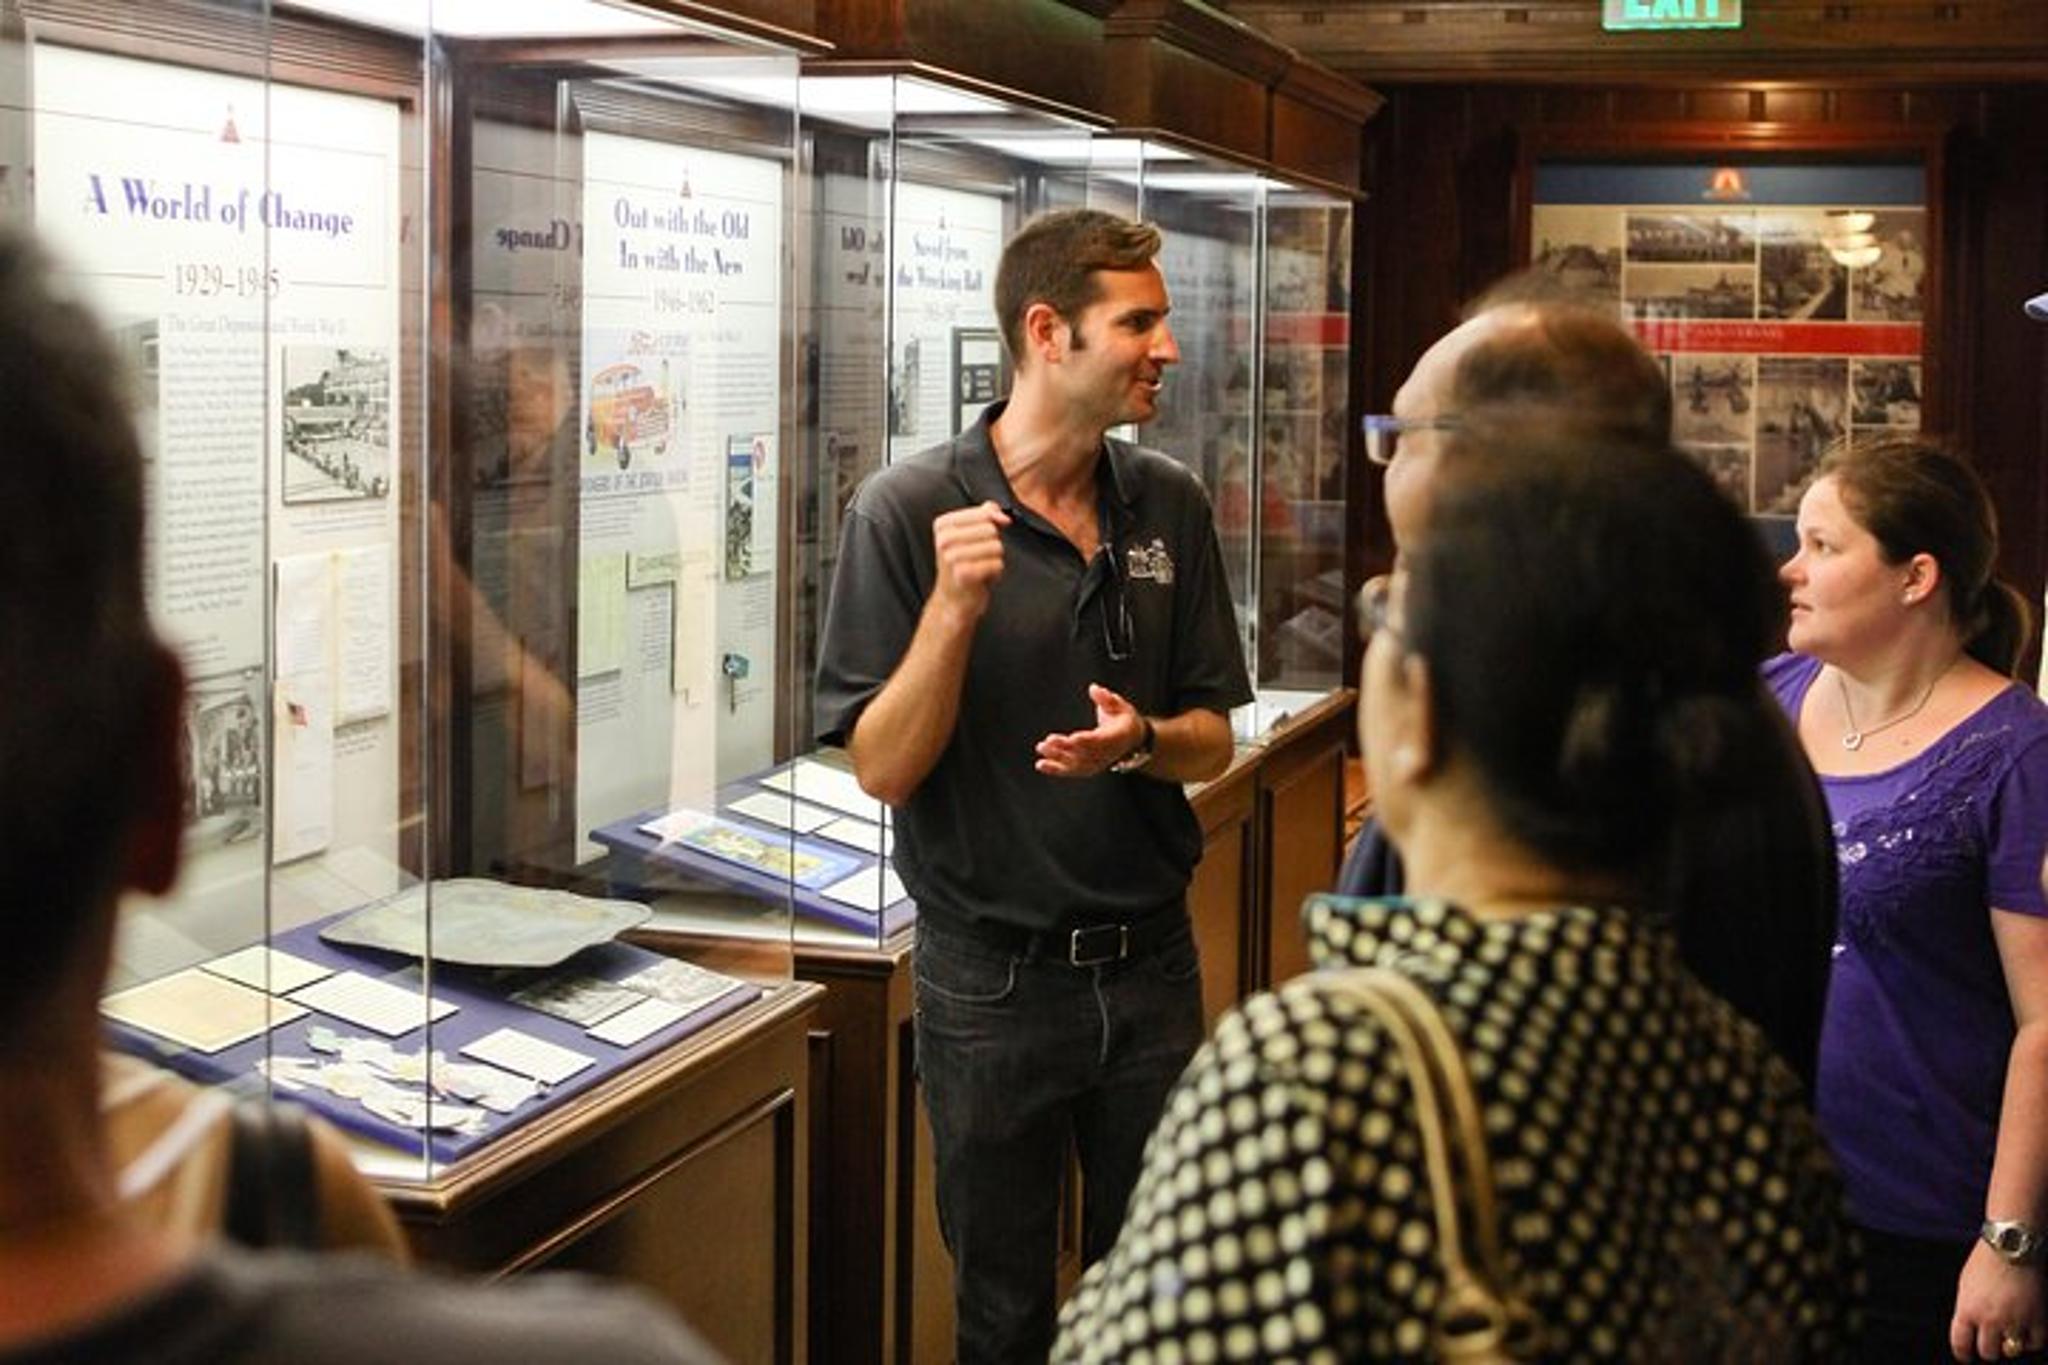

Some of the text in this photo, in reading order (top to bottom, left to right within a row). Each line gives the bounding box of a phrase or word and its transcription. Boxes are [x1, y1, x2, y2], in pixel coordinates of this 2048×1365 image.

[84, 173, 354, 238] A World of Change
[614, 197, 749, 239] Out with the Old
[620, 240, 743, 276] In with the New
